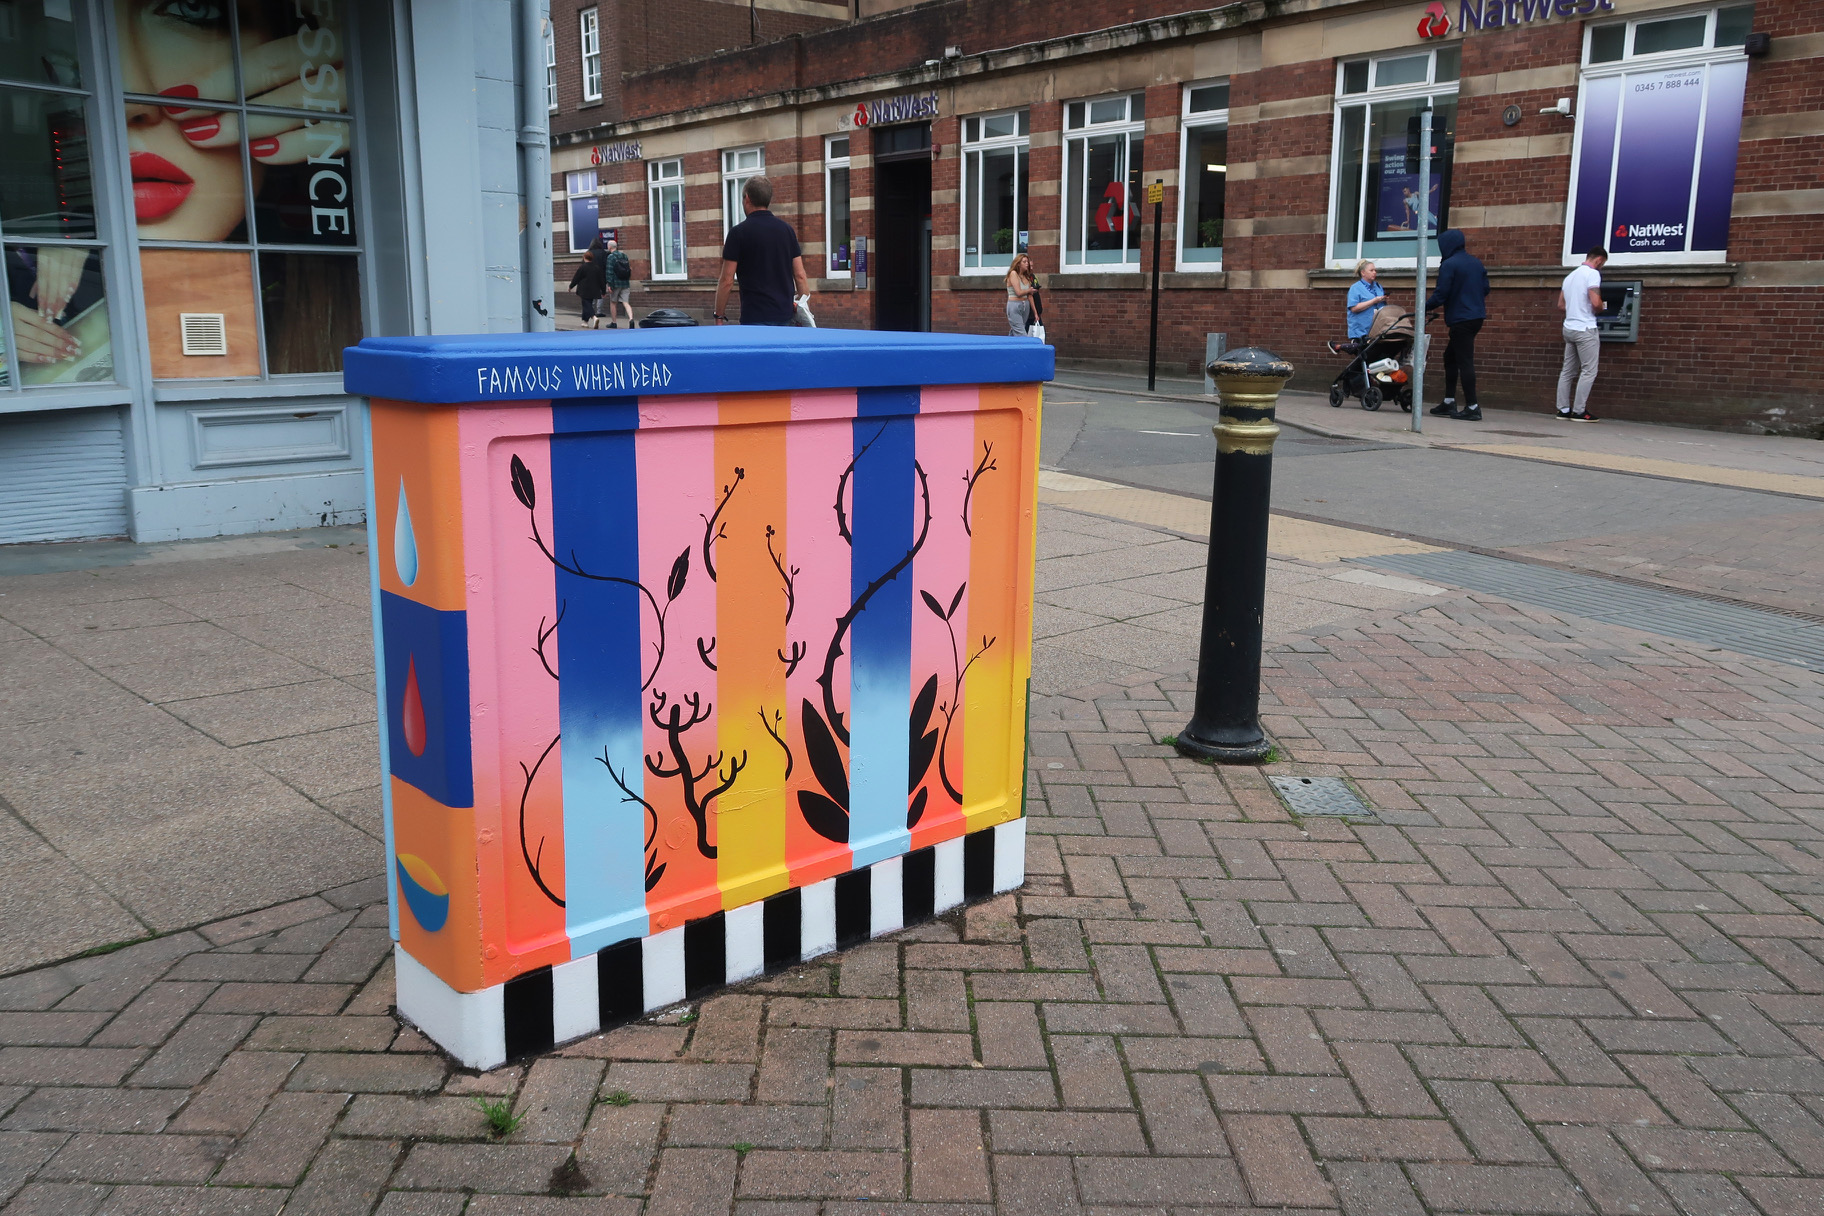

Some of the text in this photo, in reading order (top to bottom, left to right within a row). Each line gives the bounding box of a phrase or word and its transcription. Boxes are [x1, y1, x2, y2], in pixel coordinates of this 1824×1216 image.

[1635, 78, 1700, 93] 0345 7 888 444
[295, 0, 350, 235] ESSENCE
[872, 91, 938, 123] NatWest
[601, 140, 642, 163] NatWest
[1628, 223, 1684, 237] NatWest
[1629, 238, 1666, 247] Cash out
[477, 361, 673, 394] FAMOUS WHEN DEAD
